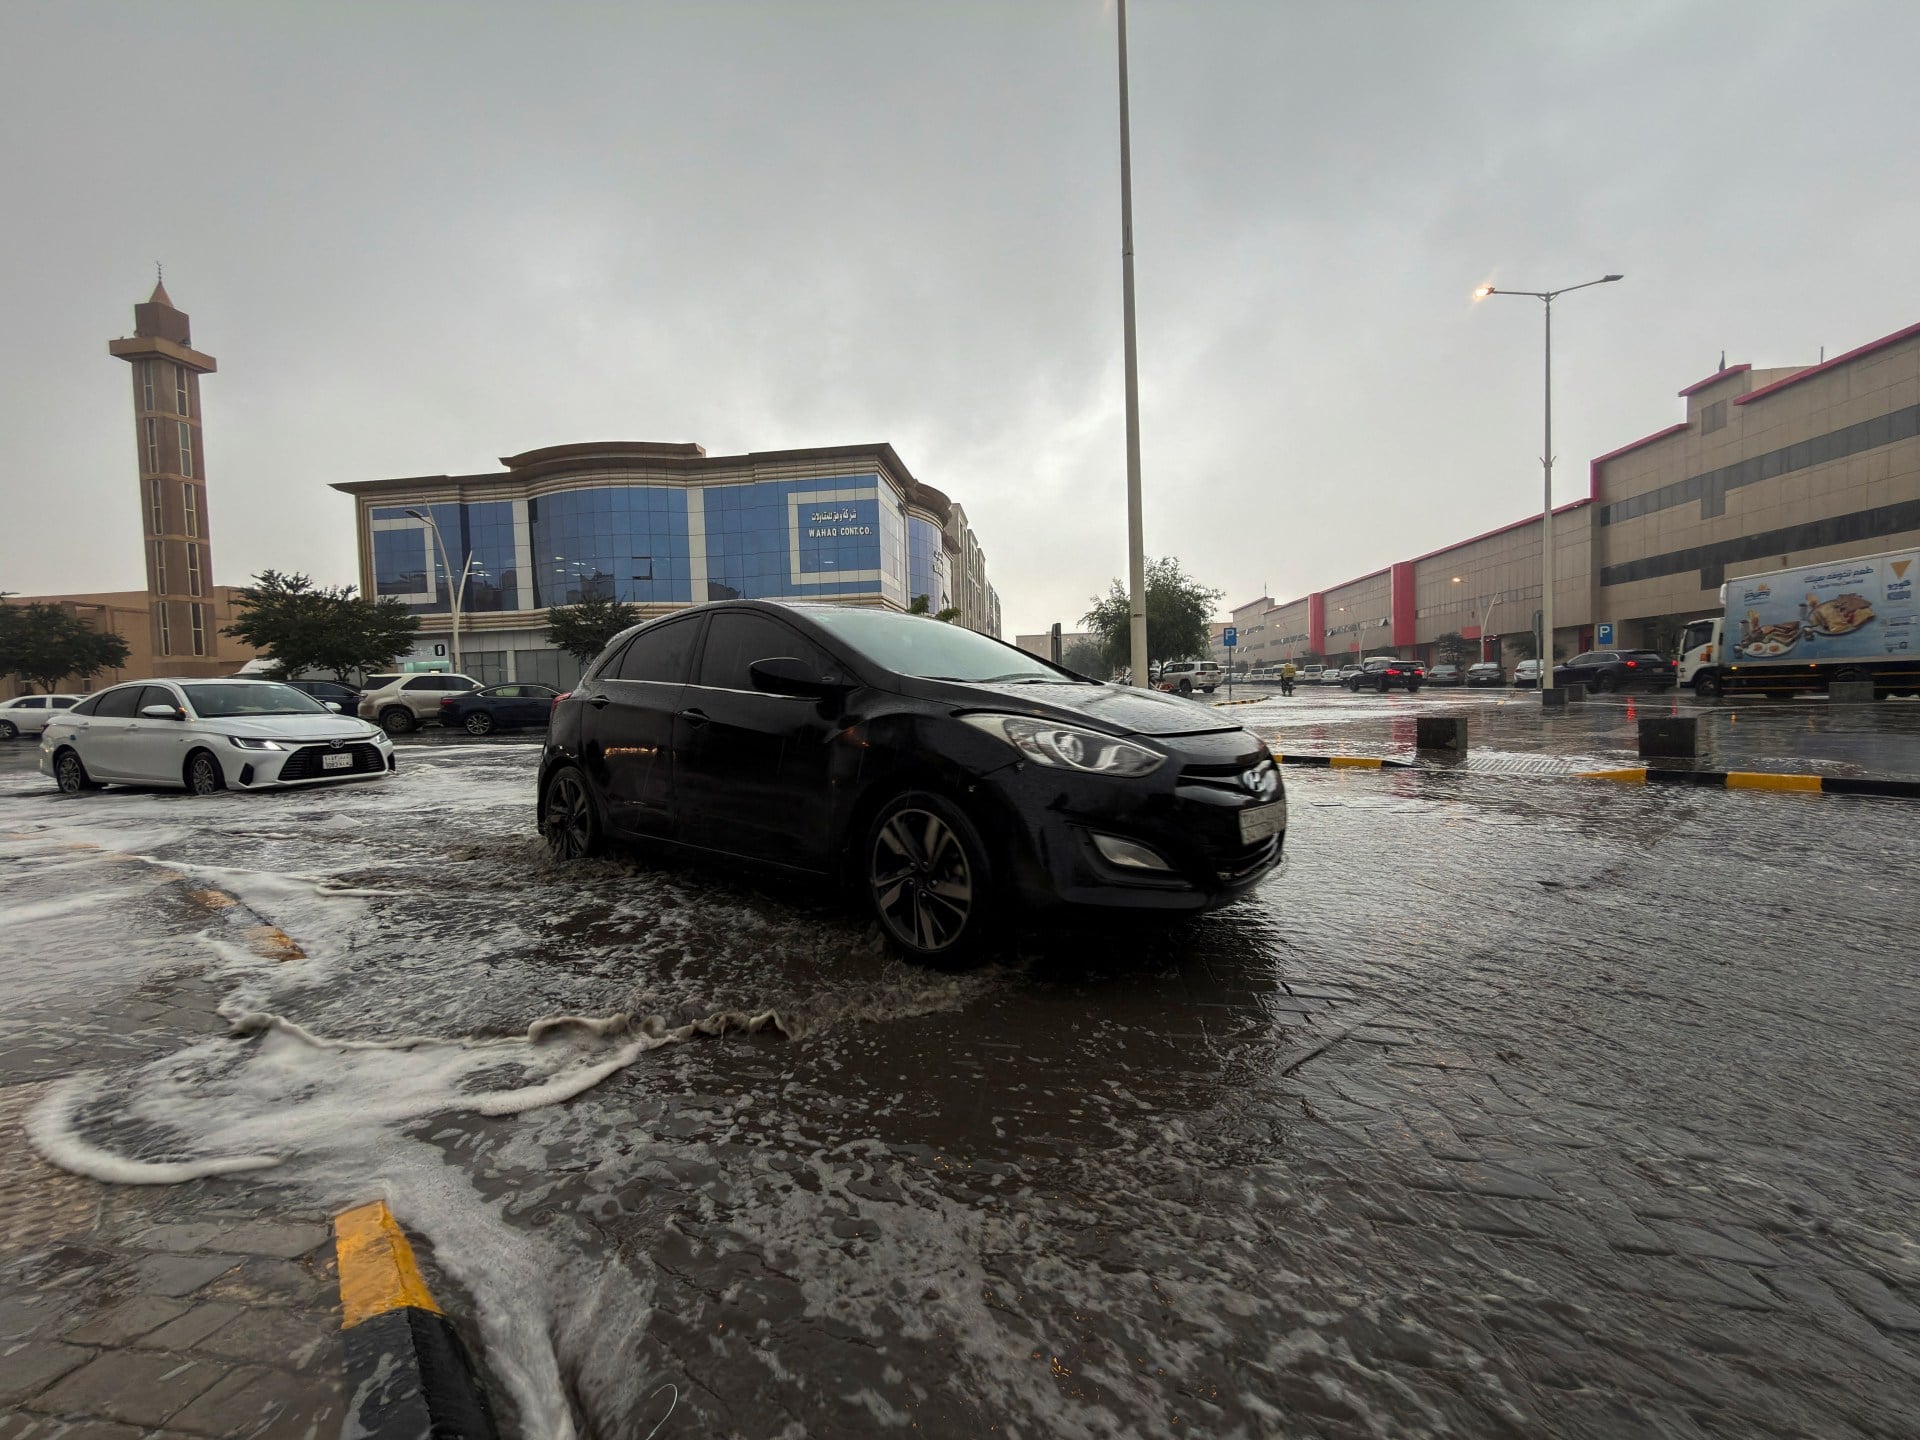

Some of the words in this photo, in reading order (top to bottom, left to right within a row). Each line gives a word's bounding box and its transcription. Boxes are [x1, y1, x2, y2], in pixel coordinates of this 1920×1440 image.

[808, 528, 837, 537] WAHAQ
[1225, 629, 1234, 640] P
[1600, 626, 1610, 637] P
